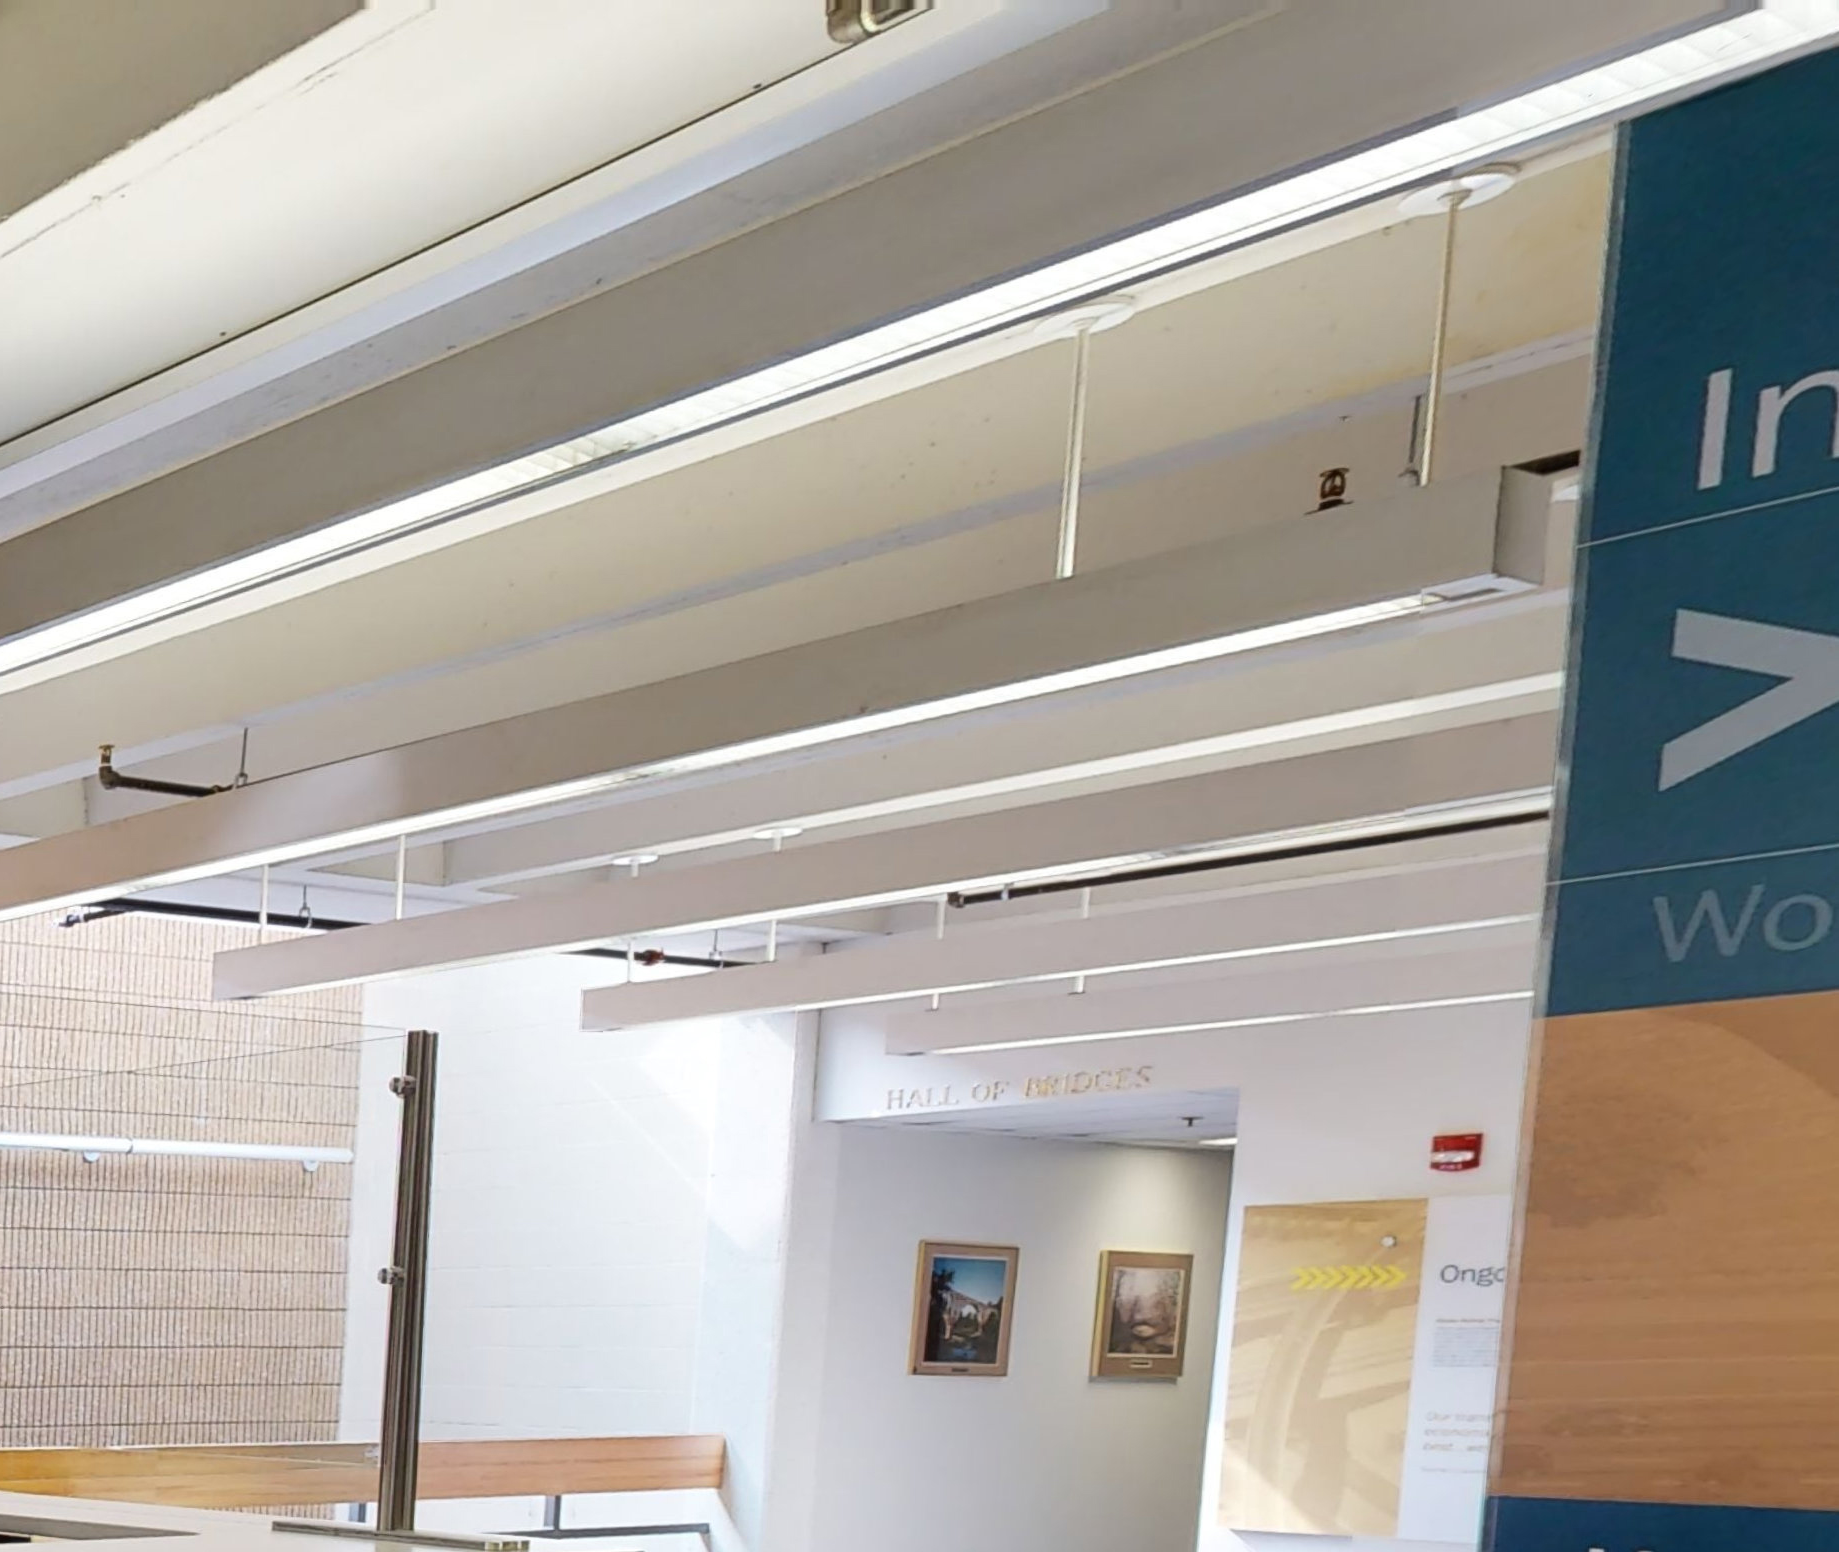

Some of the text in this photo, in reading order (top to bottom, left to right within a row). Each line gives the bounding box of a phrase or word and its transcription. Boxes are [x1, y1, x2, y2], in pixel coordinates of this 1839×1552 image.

[1653, 884, 1833, 962] Wo
[887, 1065, 1153, 1110] HALL OF BRIDGES
